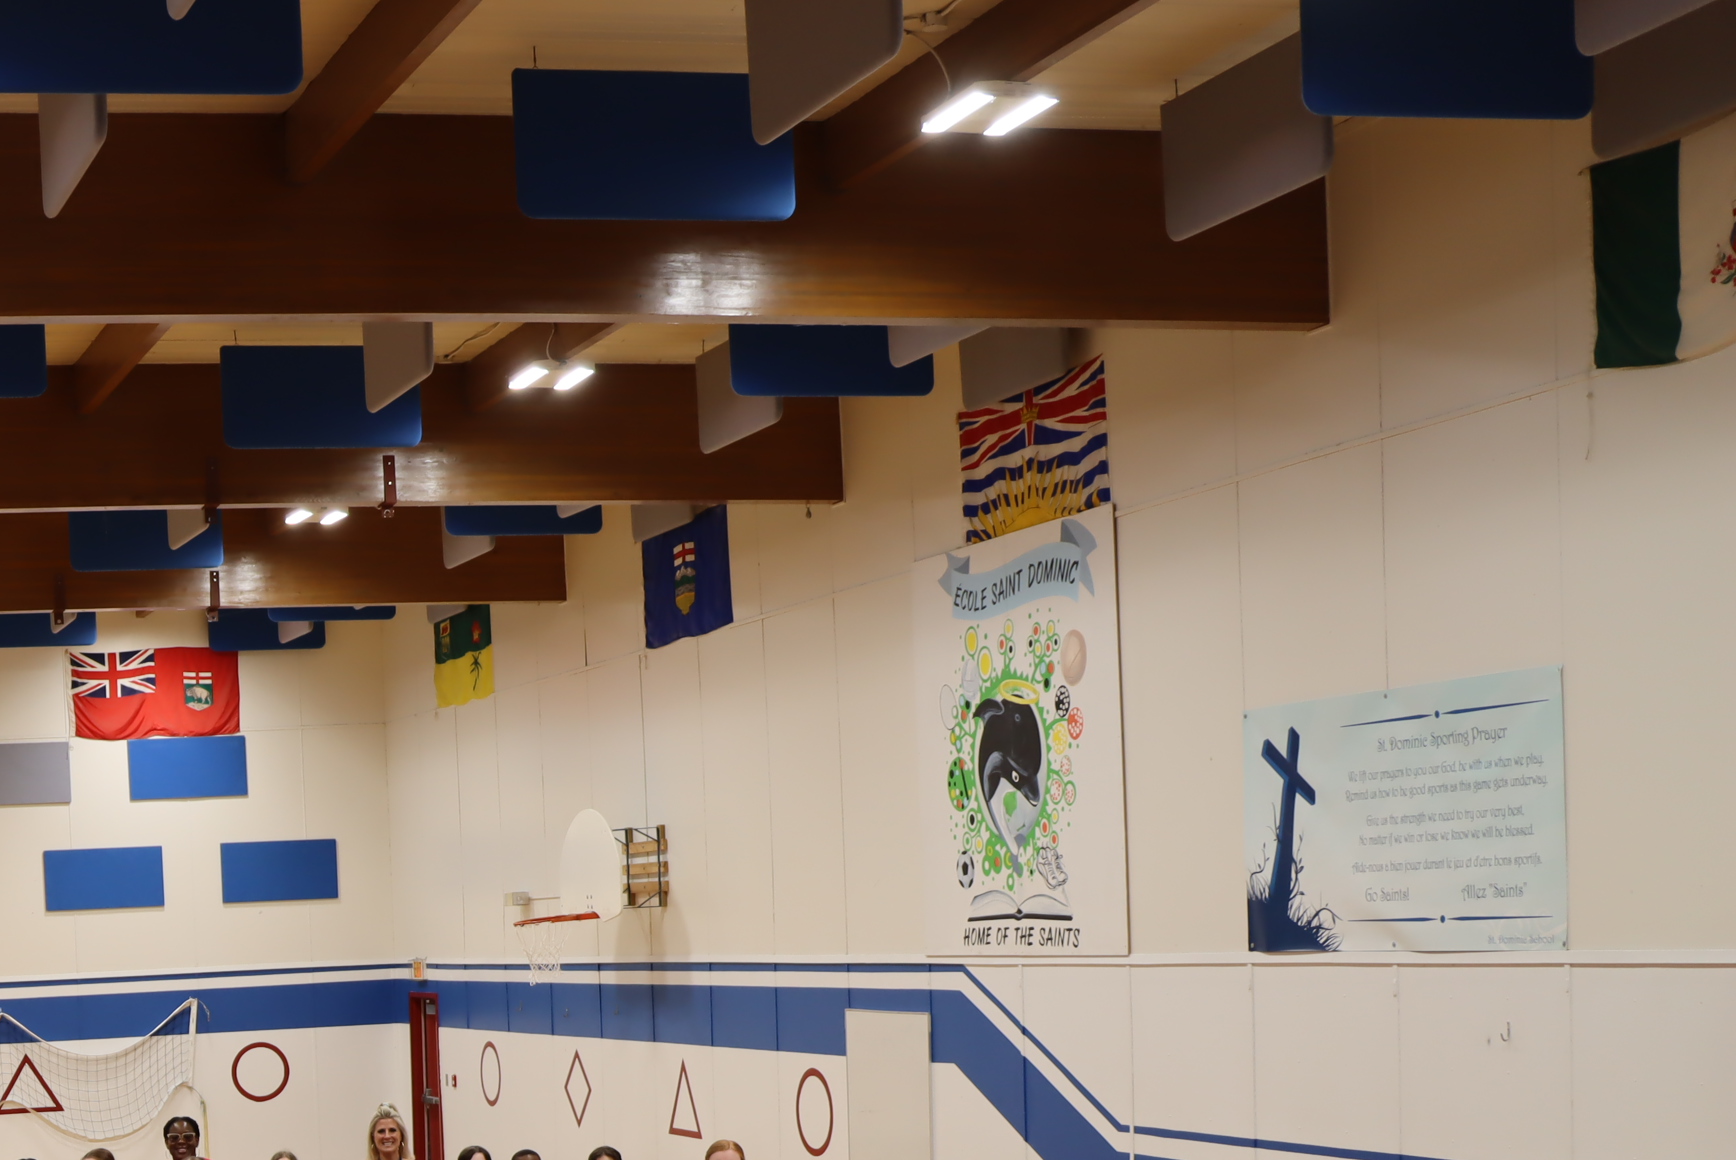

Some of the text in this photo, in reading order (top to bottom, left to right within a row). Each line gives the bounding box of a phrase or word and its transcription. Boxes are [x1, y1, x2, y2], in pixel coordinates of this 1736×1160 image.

[954, 558, 1079, 612] ÉCOLE SAINT DOMINIC
[1377, 727, 1508, 752] St. Dominic Sporting Prayer
[1368, 772, 1379, 780] our
[1380, 769, 1404, 781] prayers
[1405, 767, 1412, 777] to
[1413, 766, 1427, 779] you
[1428, 765, 1440, 775] our
[1469, 758, 1483, 770] with
[1484, 760, 1492, 769] us
[1493, 756, 1512, 767] when
[1513, 756, 1524, 766] we
[1370, 791, 1377, 799] us
[1378, 788, 1390, 798] how
[1392, 787, 1399, 797] to
[1400, 786, 1407, 796] be
[1409, 783, 1426, 799] good
[1427, 783, 1448, 796] sports
[1450, 784, 1458, 792] as
[1459, 780, 1471, 791] this
[1473, 780, 1491, 793] game
[1493, 778, 1508, 791] gets
[1367, 815, 1379, 826] Give
[1389, 814, 1399, 824] the
[1400, 812, 1426, 826] strength
[1428, 813, 1437, 821] we
[1438, 809, 1455, 821] need
[1456, 809, 1464, 820] to
[1465, 809, 1474, 822] try
[1475, 809, 1488, 818] our
[1489, 808, 1506, 820] very
[1394, 834, 1402, 843] we
[1404, 833, 1415, 842] win
[1416, 833, 1424, 842] or
[1425, 830, 1439, 841] lose
[1440, 831, 1450, 840] we
[1451, 829, 1469, 840] know
[1470, 829, 1480, 838] we
[1482, 826, 1493, 837] will
[1494, 826, 1504, 837] be
[1494, 854, 1512, 866] bons
[1365, 887, 1410, 902] Go Saints!
[1460, 884, 1488, 902] Allez
[963, 926, 1081, 948] HOME OF THE SAINTS
